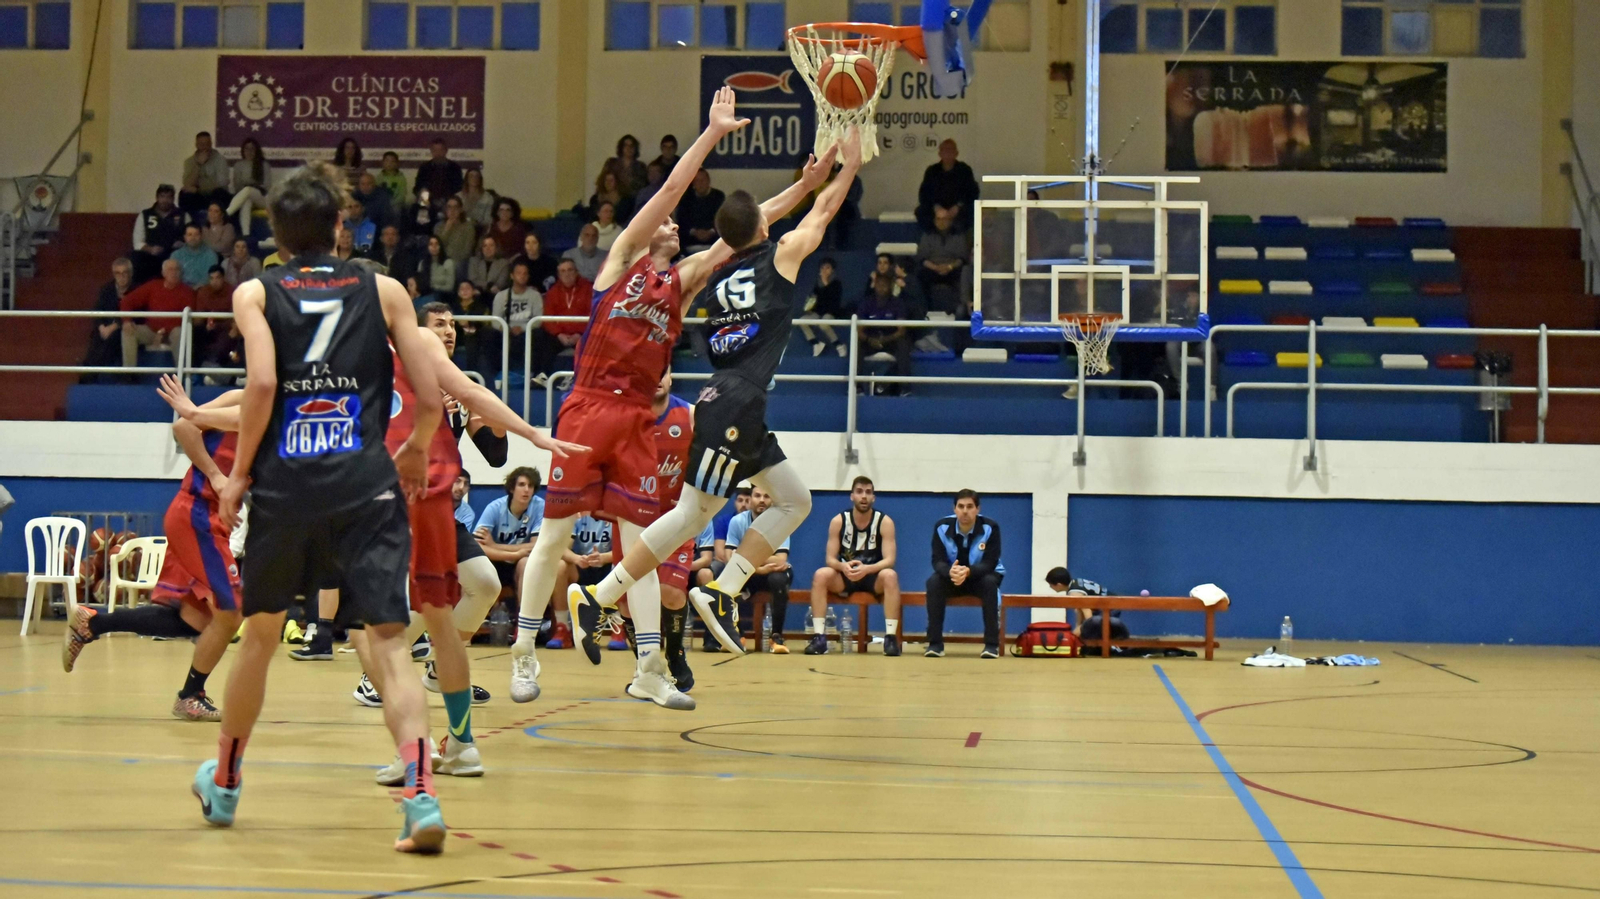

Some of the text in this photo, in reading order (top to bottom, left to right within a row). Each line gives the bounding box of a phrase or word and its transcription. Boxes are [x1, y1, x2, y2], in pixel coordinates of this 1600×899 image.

[331, 73, 440, 93] CLÍNICAS
[1228, 66, 1257, 83] LA
[1183, 86, 1302, 101] SERRADA
[293, 96, 476, 119] DR. ESPINEL
[293, 122, 476, 132] CENTROS DENTALES ESPECIALIZADOS
[874, 112, 969, 129] agogroup.com
[148, 215, 159, 229] 5
[715, 267, 756, 313] 15
[300, 299, 344, 363] 7
[312, 363, 332, 376] LA
[283, 377, 359, 393] SERRADA
[286, 421, 353, 454] UBAGO
[639, 475, 657, 494] 10
[580, 530, 611, 543] ULB
